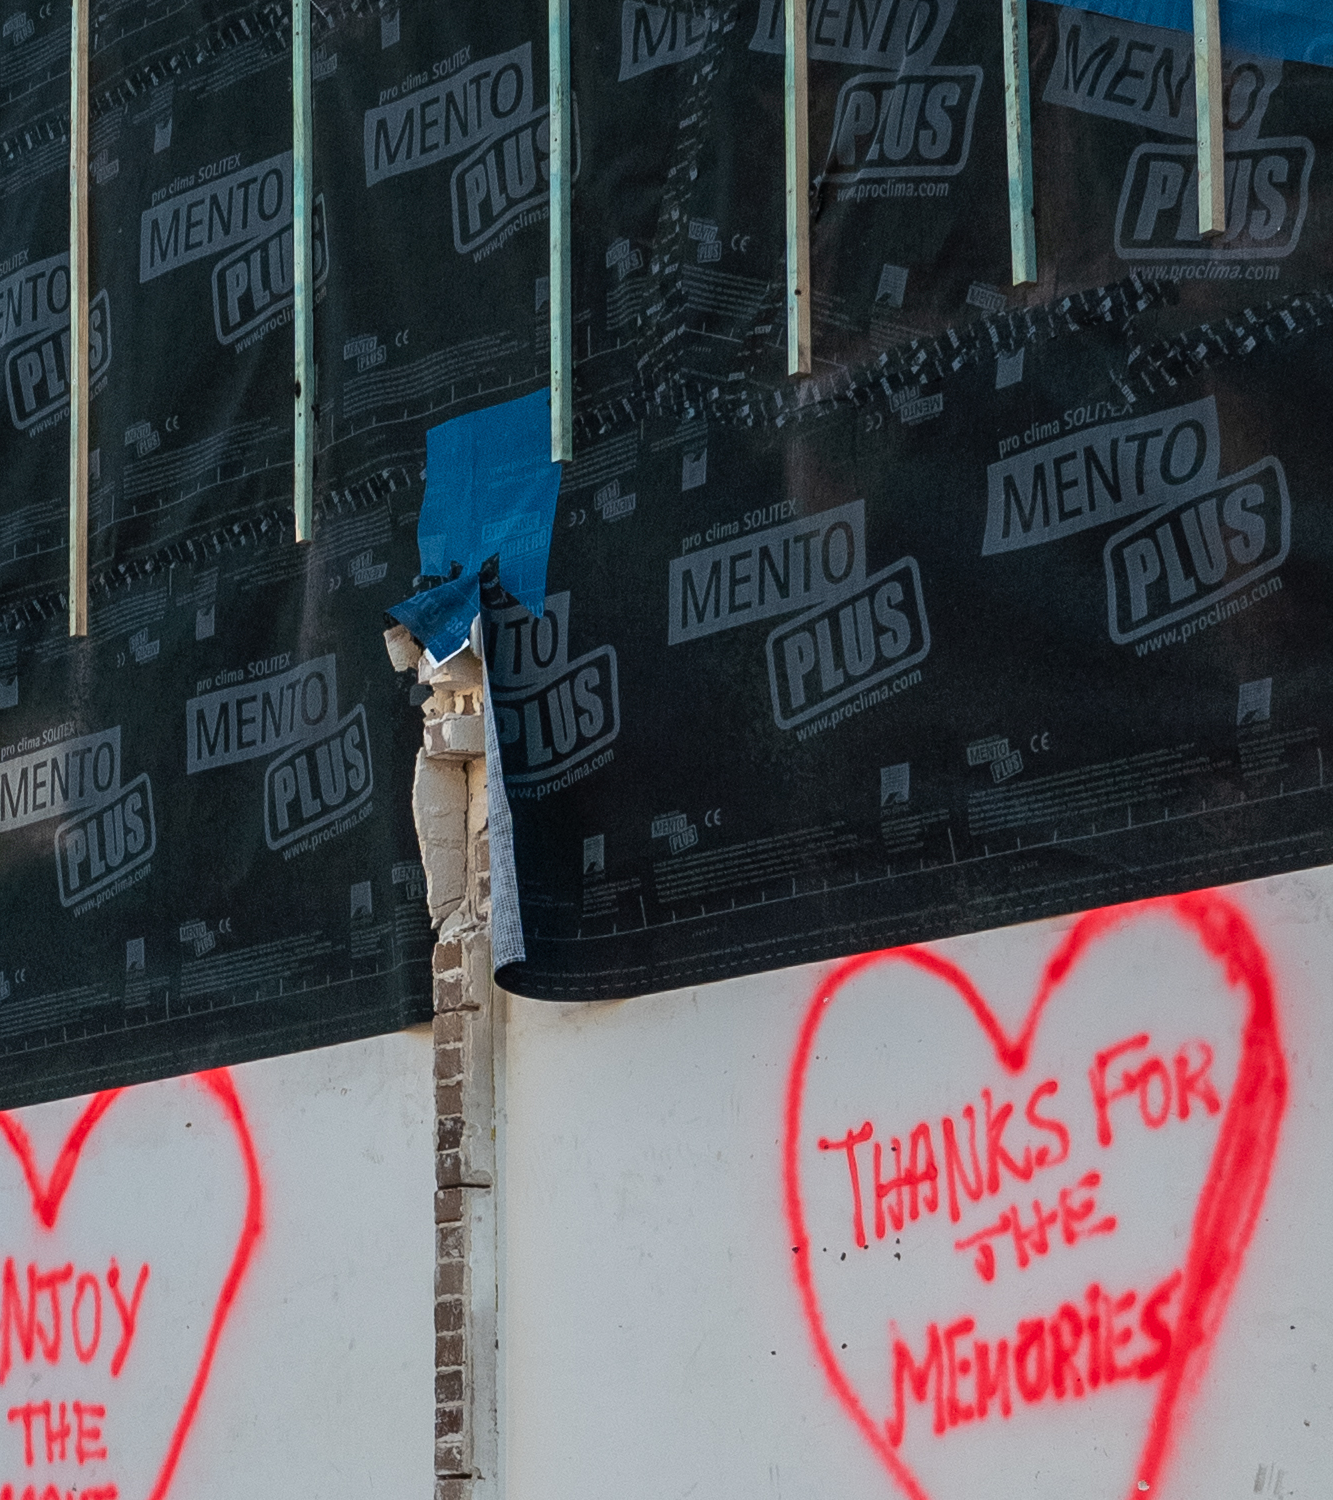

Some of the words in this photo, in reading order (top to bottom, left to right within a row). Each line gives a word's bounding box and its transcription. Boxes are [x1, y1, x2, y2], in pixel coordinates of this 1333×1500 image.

[379, 83, 397, 104] pro
[402, 70, 428, 94] clima
[433, 46, 470, 79] SOLITEX
[1064, 25, 1264, 130] MENO
[373, 63, 523, 170] MENTO
[150, 169, 282, 268] MENTO
[152, 189, 167, 206] pro
[169, 175, 194, 196] clima
[198, 153, 241, 184] SOLITEX
[0, 248, 28, 275] SOLITEX
[1129, 261, 1279, 281] www.proclima.com
[998, 435, 1019, 458] pro
[1025, 418, 1059, 444] clima
[1001, 419, 1207, 538] MENTO
[683, 534, 701, 550] pro
[705, 521, 739, 543] clima
[743, 499, 796, 530] SOLITEX
[1123, 483, 1266, 620] PLUS
[682, 521, 855, 629] MENTO
[784, 581, 911, 708] PLUS
[1136, 576, 1282, 657] www.proclima.com
[197, 679, 212, 695] pro
[215, 668, 244, 687] clima
[248, 652, 291, 677] SOLITEX
[796, 669, 922, 742] www.proclima.com
[0, 745, 15, 761] pro
[17, 734, 40, 753] clima
[42, 722, 76, 747] SOLITEX
[196, 672, 328, 760] MENTO
[0, 742, 112, 821] MENTO
[274, 726, 366, 834] PLUS
[67, 793, 145, 890] PLUS
[283, 801, 374, 860] www.proclima.com
[72, 863, 151, 917] www.proclima.com
[817, 1080, 1070, 1248] THANKS
[1089, 1032, 1220, 1146] FOR
[954, 1171, 1117, 1281] THE
[886, 1271, 1183, 1448] MEMORIES
[8, 1401, 108, 1465] THE
